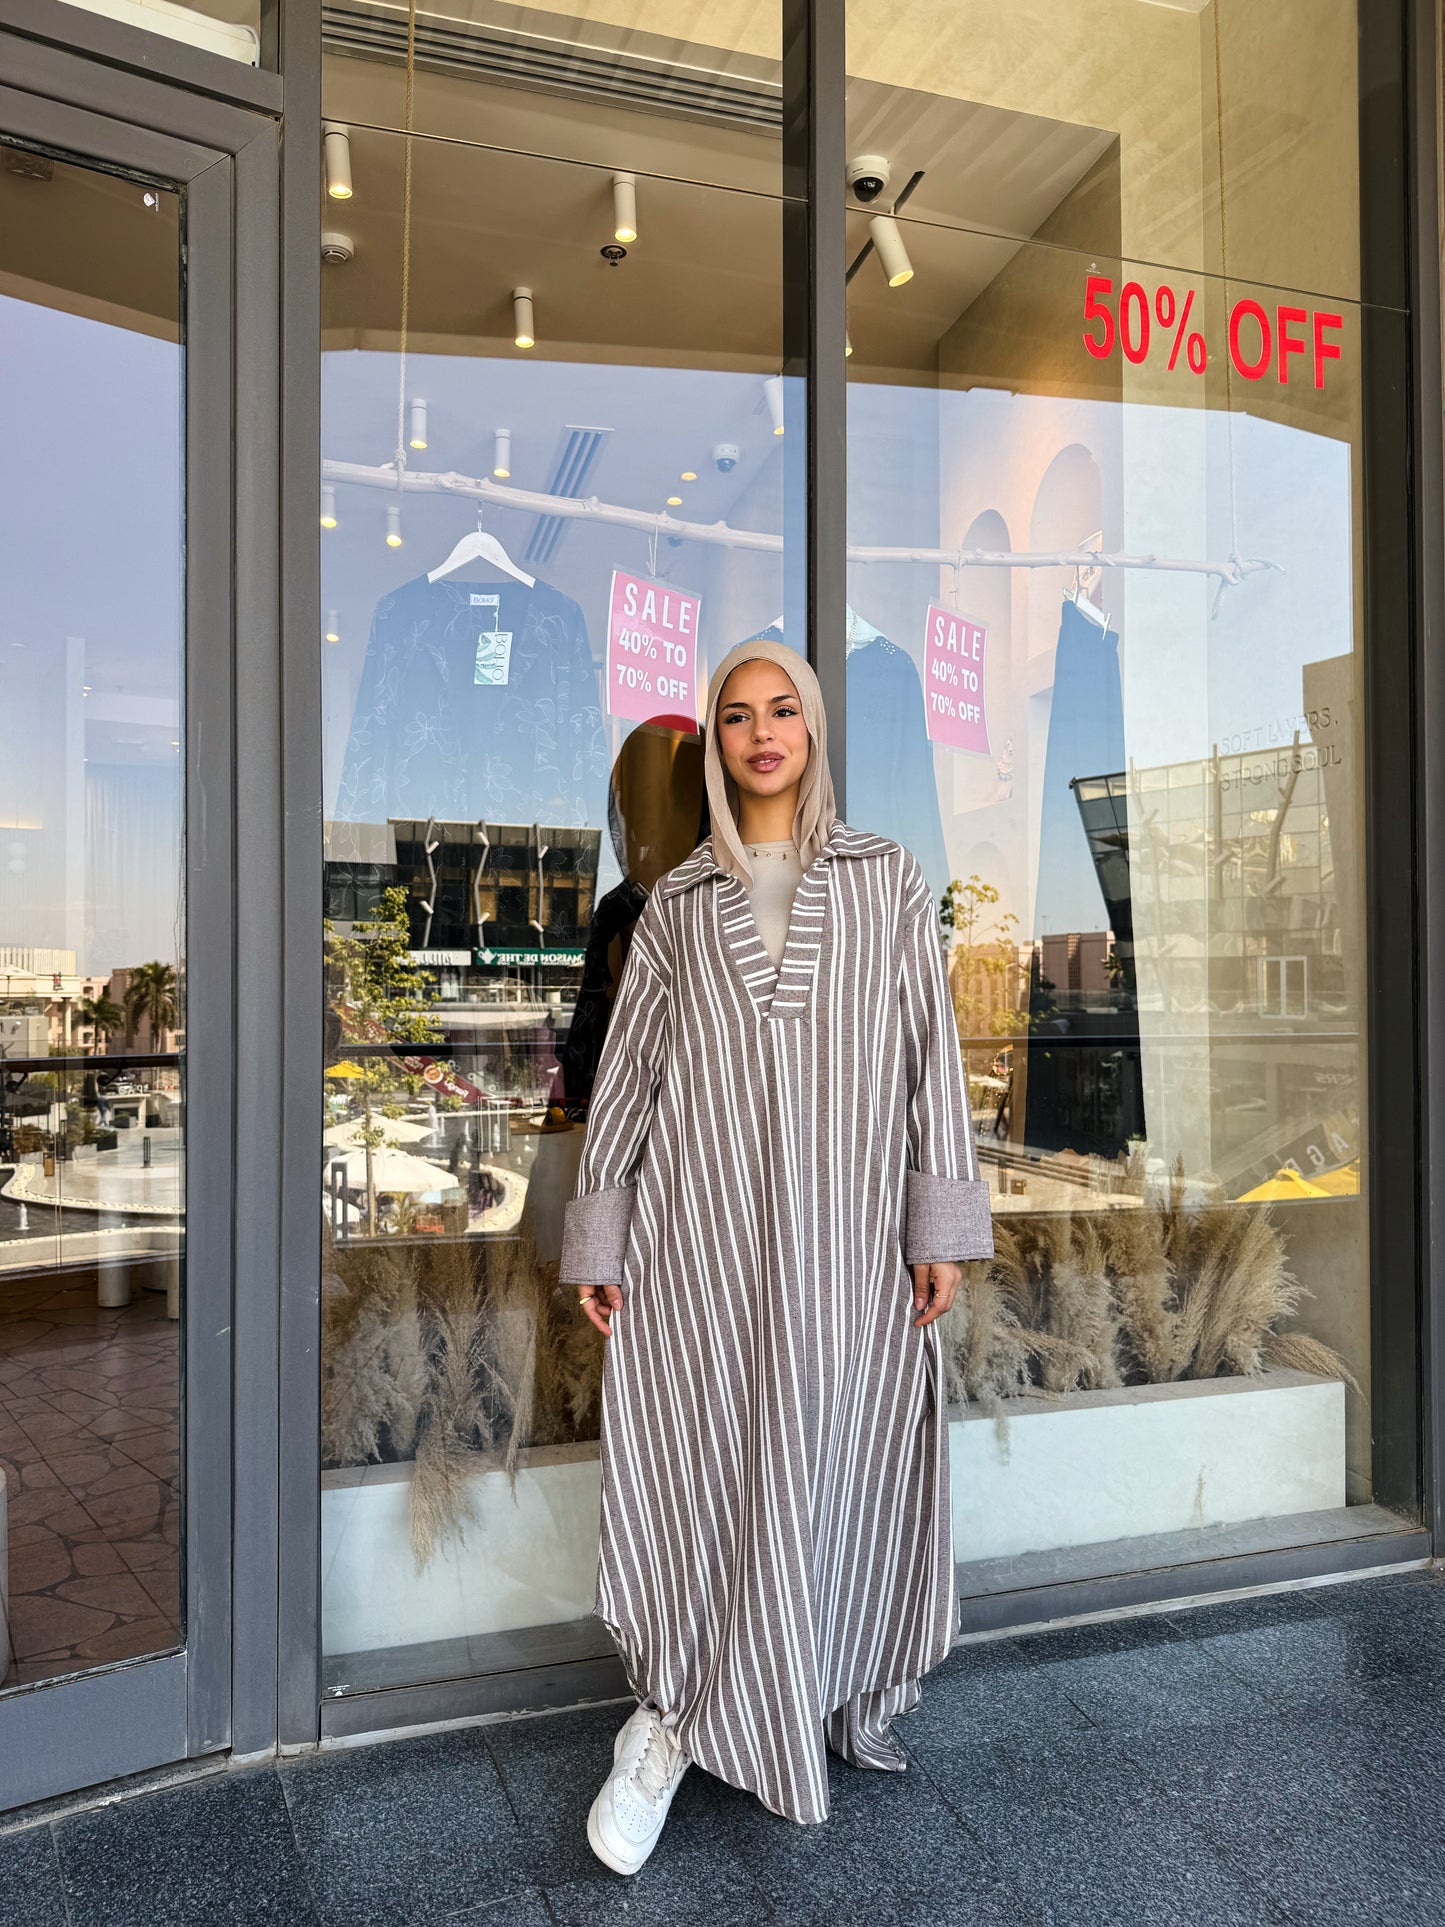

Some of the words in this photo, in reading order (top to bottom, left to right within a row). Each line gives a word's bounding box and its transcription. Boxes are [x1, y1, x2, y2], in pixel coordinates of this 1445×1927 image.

[1083, 275, 1207, 375] 50%
[1229, 298, 1343, 389] OFF
[623, 582, 692, 635] SALE
[619, 627, 657, 660] 40%
[663, 640, 687, 668] TO
[934, 615, 981, 662] SALE
[616, 663, 652, 693] 70%
[657, 675, 688, 701] OFF
[931, 657, 958, 687] 40%
[961, 668, 979, 693] TO
[930, 691, 956, 718] 70%
[958, 701, 981, 724] OFF
[1220, 728, 1263, 755] SOFT
[1221, 759, 1288, 792] STRONG
[1291, 745, 1342, 774] SOUL
